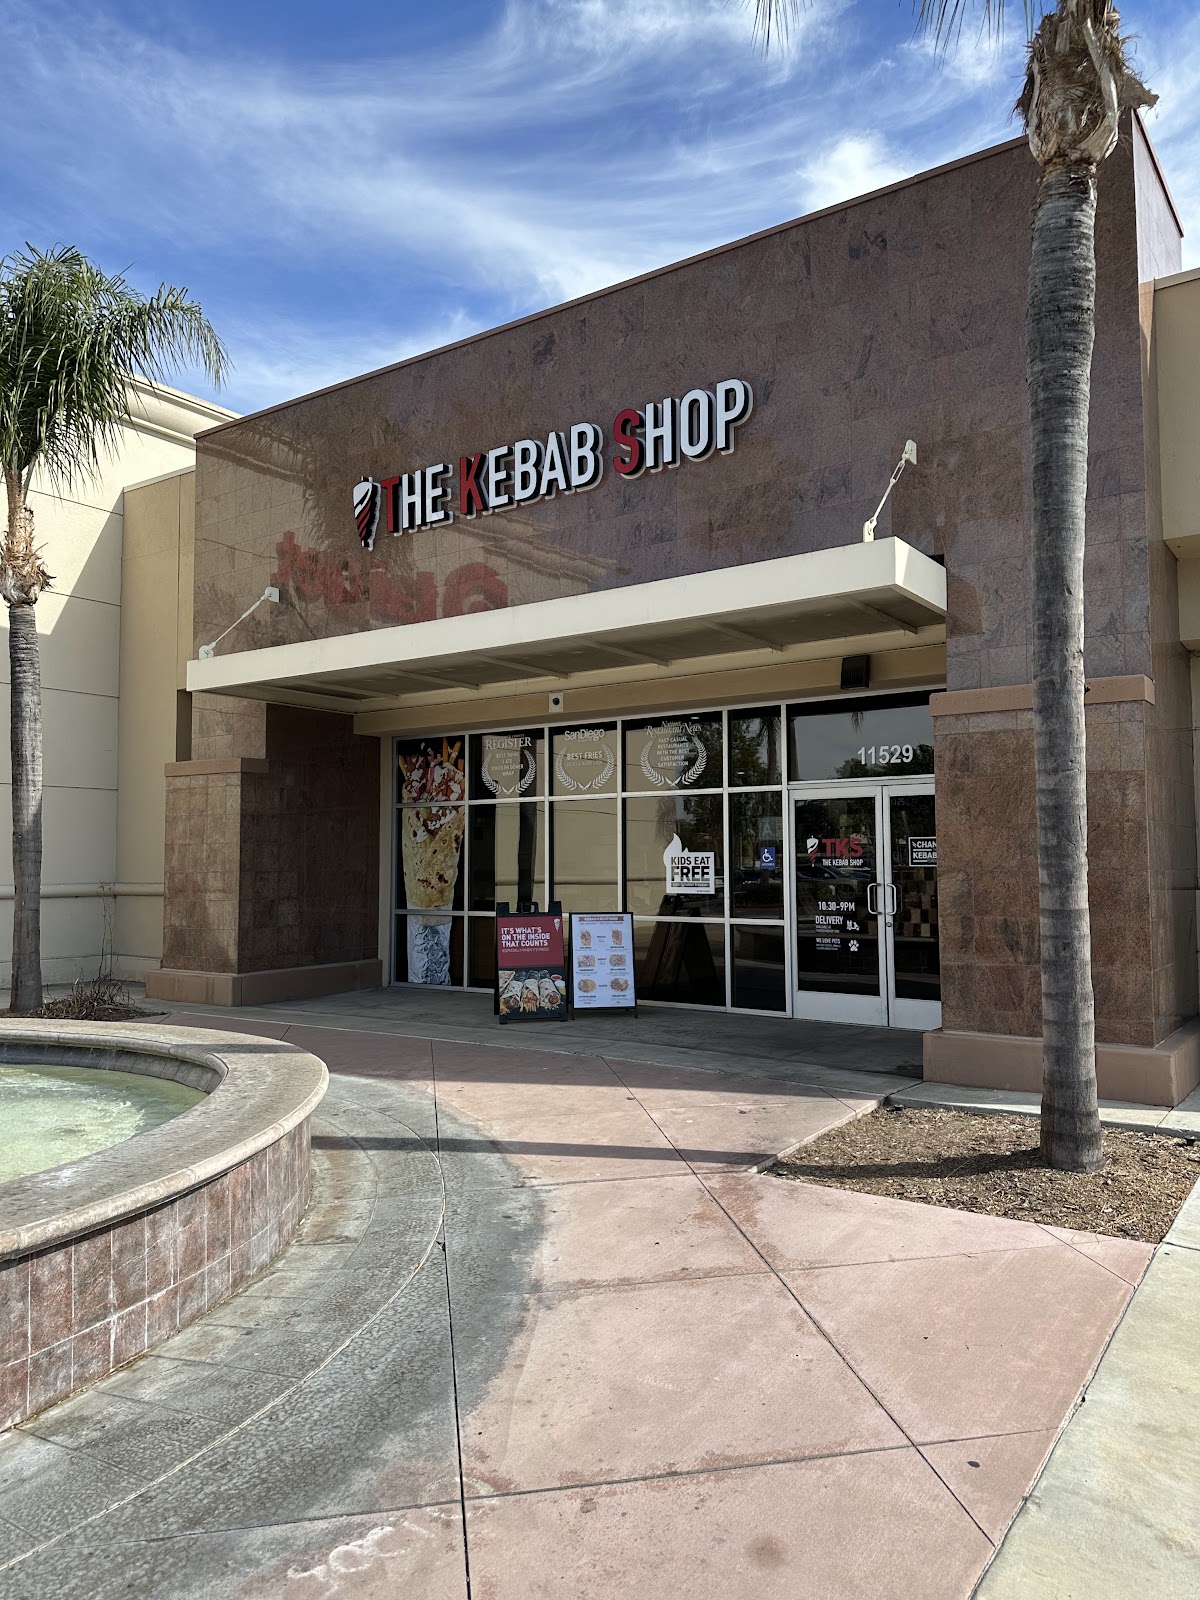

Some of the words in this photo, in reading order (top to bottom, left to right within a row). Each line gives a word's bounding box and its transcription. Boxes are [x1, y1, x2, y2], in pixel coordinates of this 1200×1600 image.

[381, 463, 452, 535] THE
[460, 422, 602, 517] KEBAB
[613, 378, 752, 478] SHOP
[564, 729, 605, 741] SanDiego
[644, 724, 685, 738] Restaurant
[683, 722, 702, 735] News
[485, 737, 532, 750] REGISTER
[566, 752, 583, 761] BEST
[584, 751, 603, 759] FRIES
[857, 744, 914, 765] 11529
[822, 838, 863, 857] TKS
[671, 856, 692, 866] KIDS
[694, 856, 711, 865] EAT
[850, 859, 864, 867] SHOP
[671, 866, 711, 881] FREE
[815, 915, 844, 925] DELIVERY
